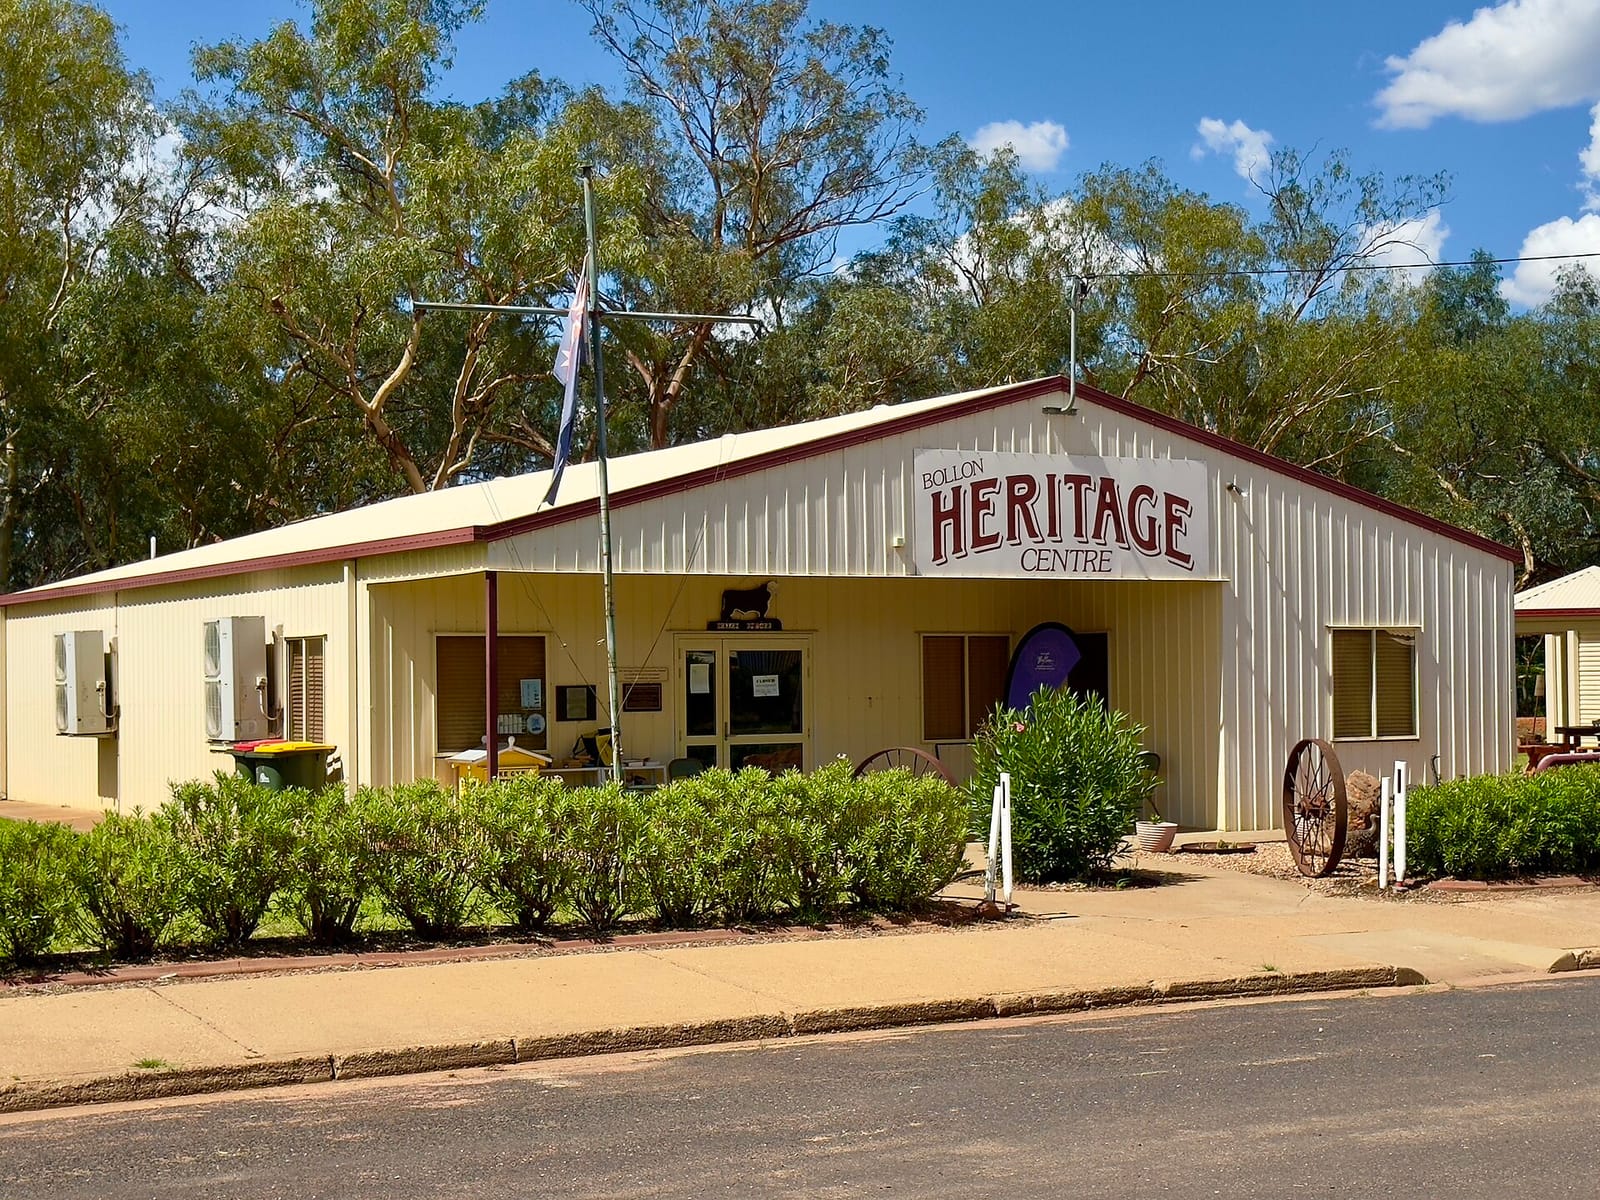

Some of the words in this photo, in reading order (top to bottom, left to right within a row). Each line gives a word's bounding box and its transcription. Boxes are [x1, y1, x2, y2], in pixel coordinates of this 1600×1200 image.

[922, 458, 985, 490] BOLLON
[931, 473, 1195, 572] HERITAGE
[1020, 548, 1113, 572] CENTRE
